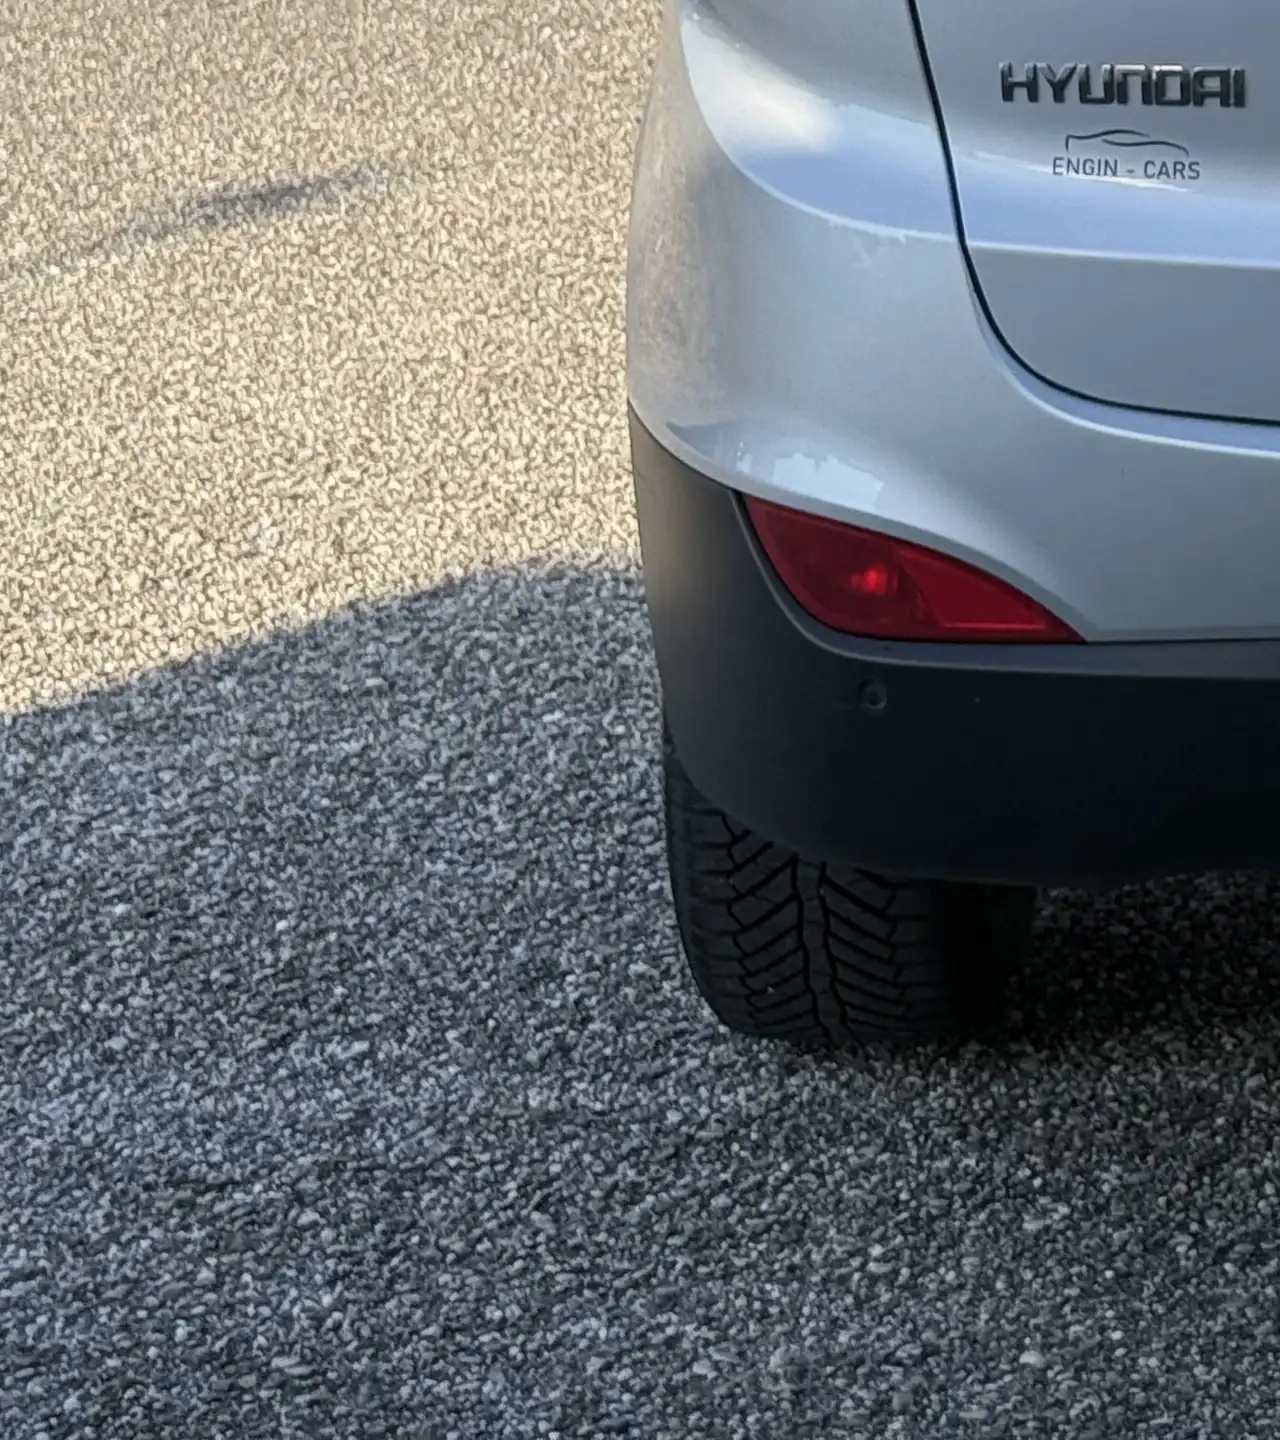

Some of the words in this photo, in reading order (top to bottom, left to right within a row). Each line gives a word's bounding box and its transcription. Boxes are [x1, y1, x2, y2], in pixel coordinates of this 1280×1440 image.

[1000, 61, 1247, 108] HYUNDAI
[1051, 157, 1119, 177] ENGIN
[1143, 160, 1201, 180] CARS
